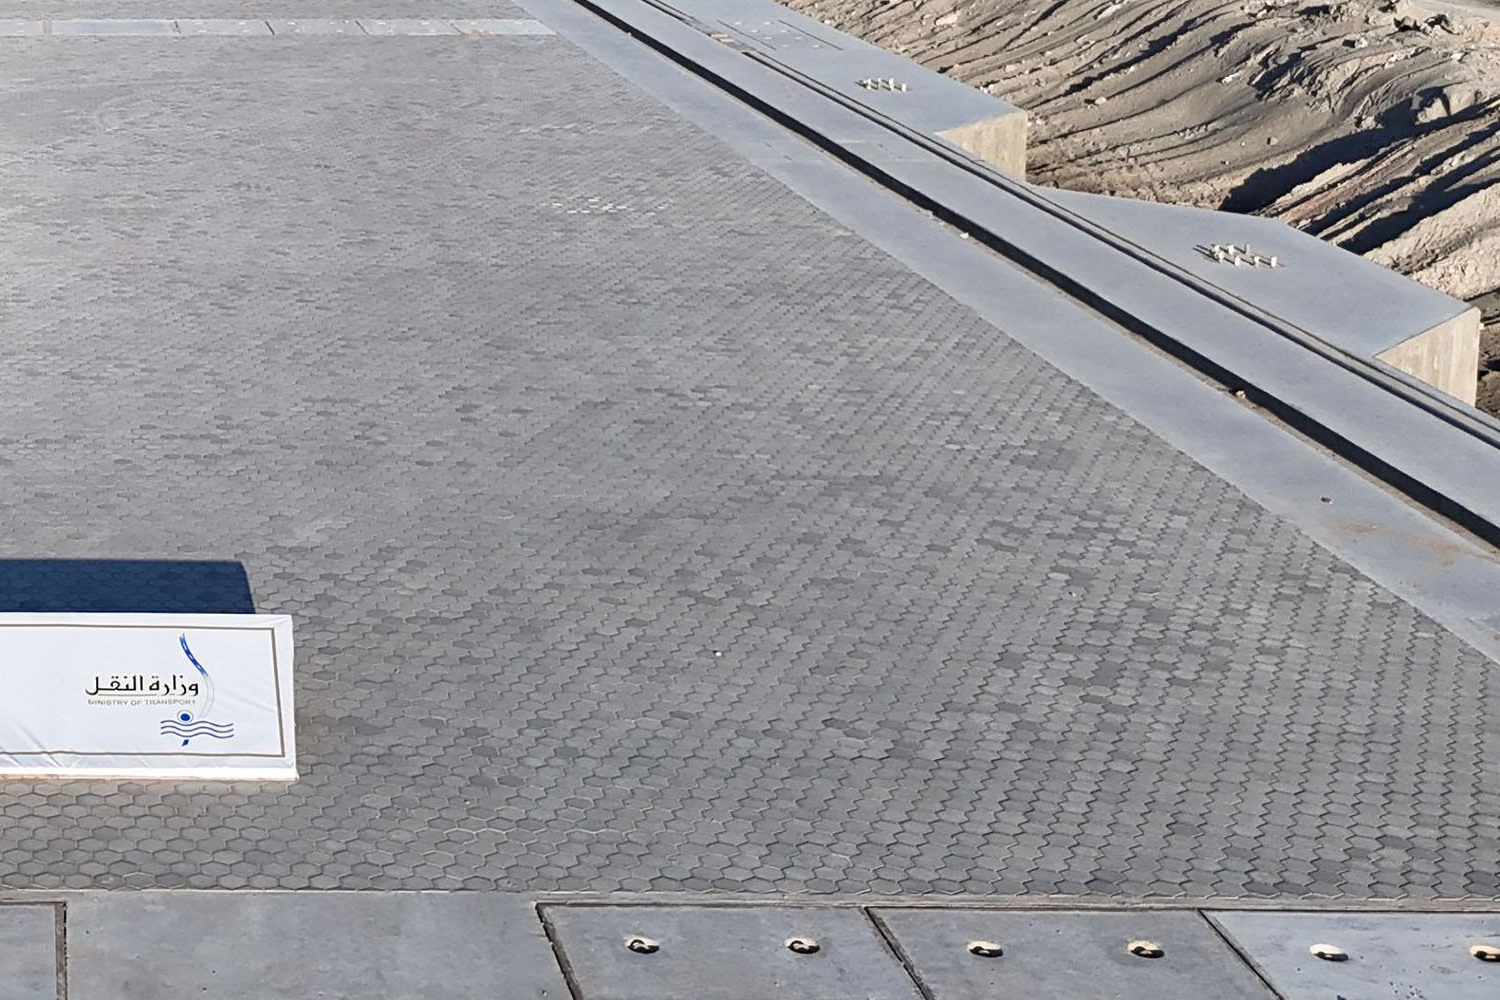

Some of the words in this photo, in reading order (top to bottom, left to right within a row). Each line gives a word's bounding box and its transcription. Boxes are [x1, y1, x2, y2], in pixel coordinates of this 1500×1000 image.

[85, 675, 143, 696] النقل
[148, 674, 199, 697] وزارة
[87, 698, 128, 706] MINISTRY
[145, 698, 197, 706] TRANSPORT
